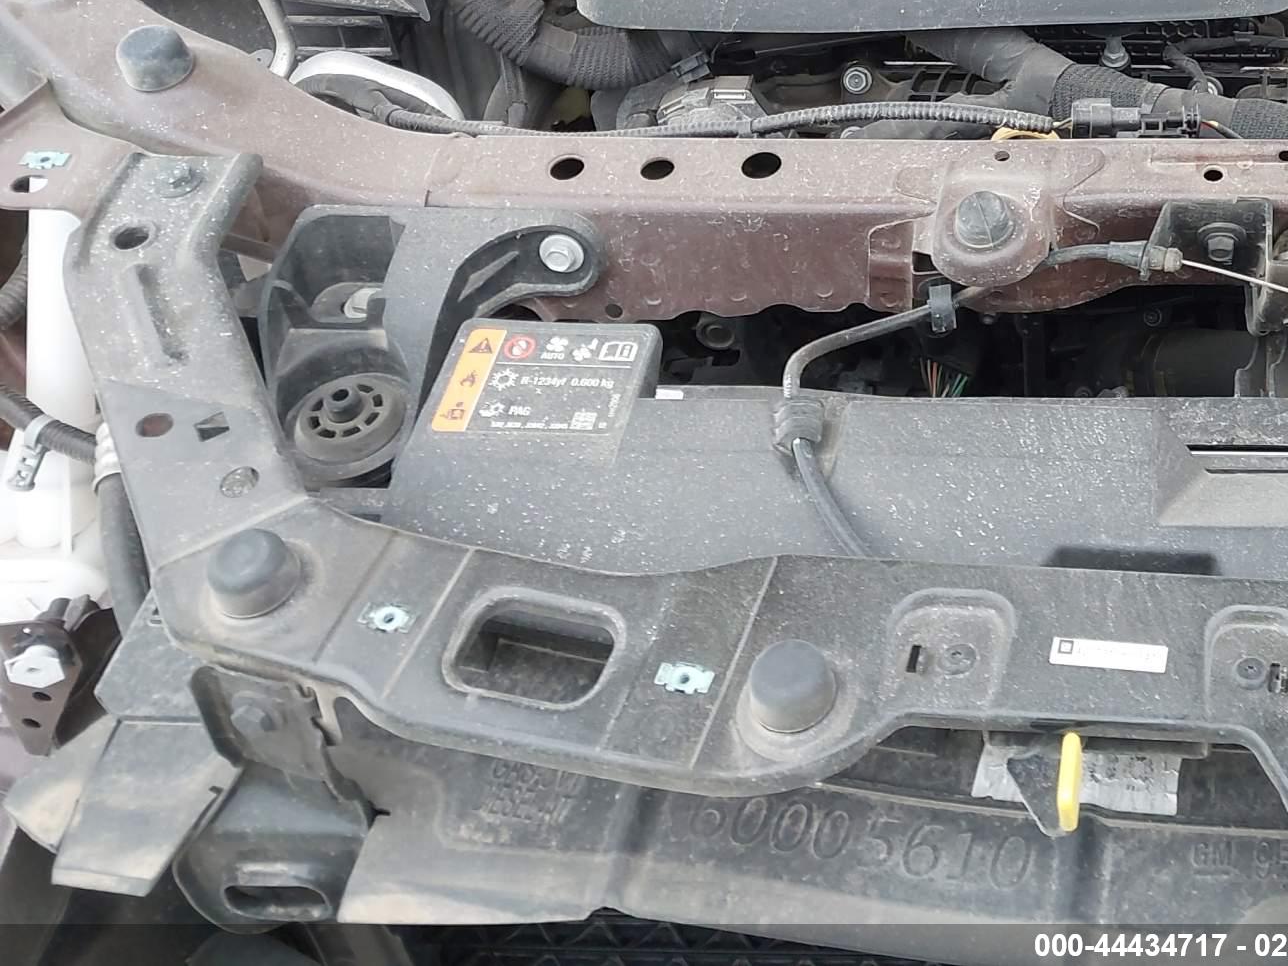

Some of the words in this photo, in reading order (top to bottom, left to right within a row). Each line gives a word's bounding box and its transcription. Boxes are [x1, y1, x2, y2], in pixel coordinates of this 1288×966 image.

[541, 352, 564, 360] AUTO
[600, 378, 615, 389] kg
[508, 405, 532, 416] PAG
